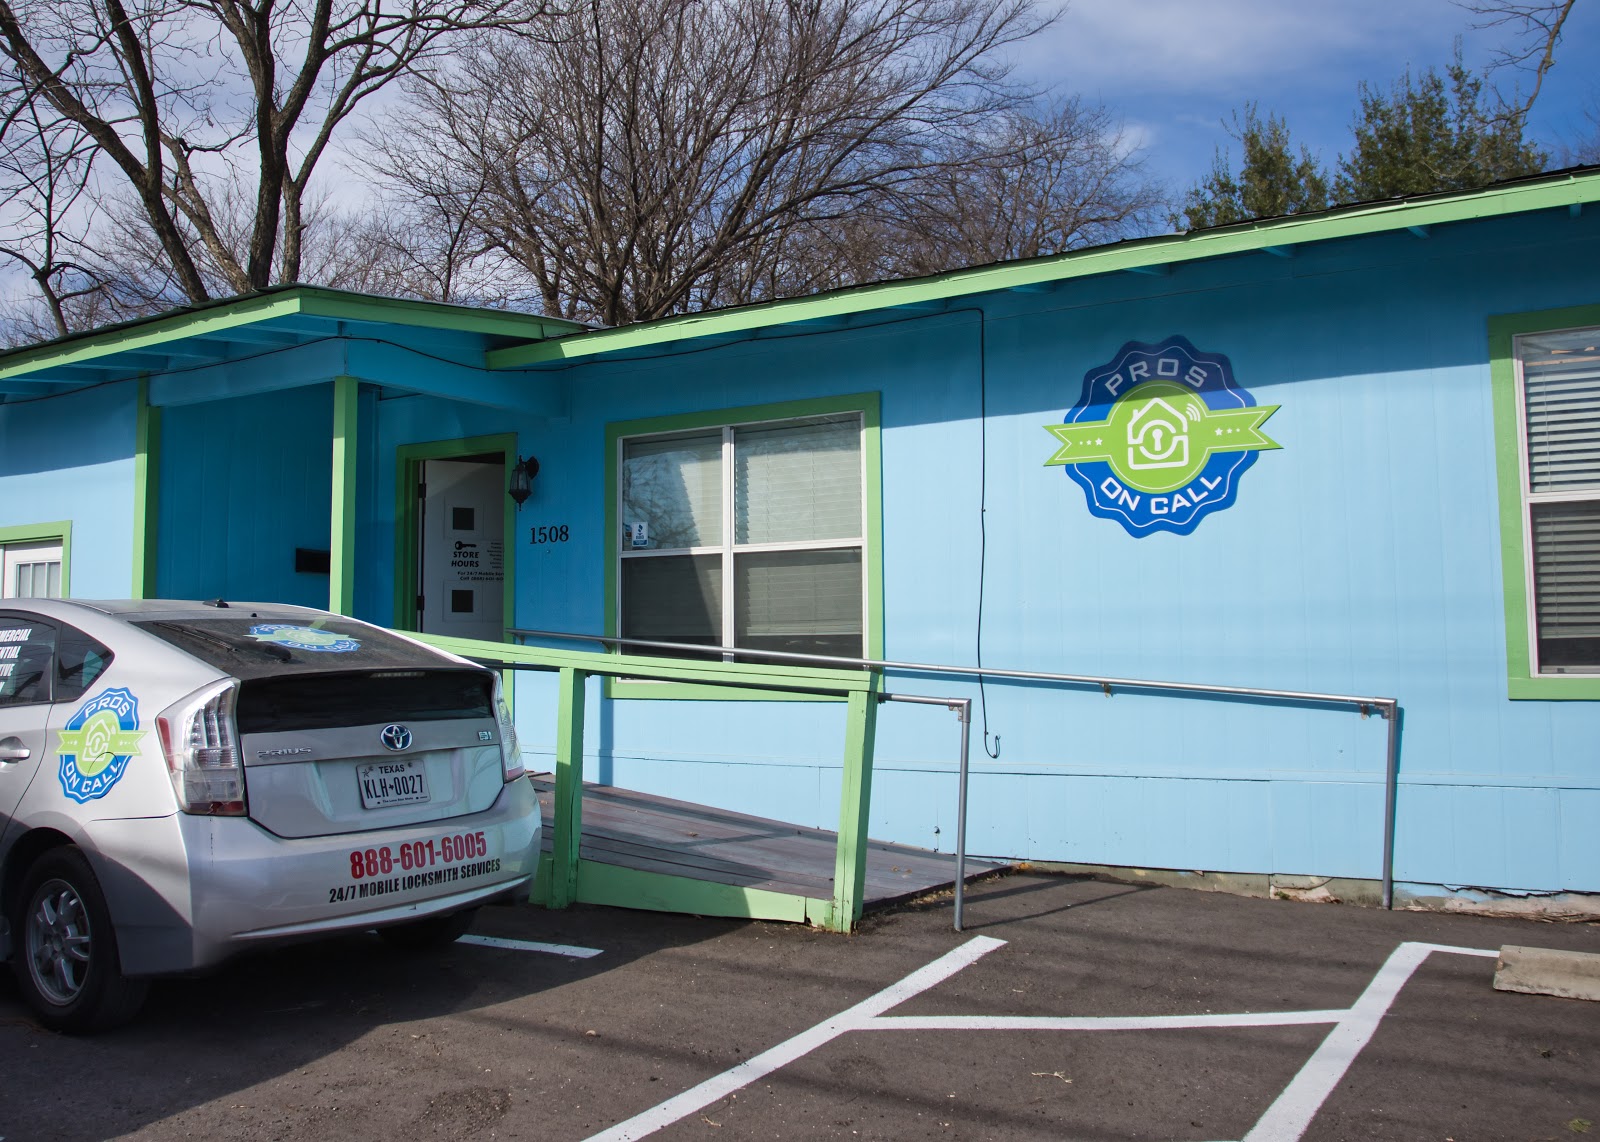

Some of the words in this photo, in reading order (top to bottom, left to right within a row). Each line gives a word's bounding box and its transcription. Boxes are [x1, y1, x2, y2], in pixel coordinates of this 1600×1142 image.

[1104, 358, 1207, 396] PROS
[1100, 476, 1141, 511] ON
[1151, 476, 1222, 514] CALL
[530, 524, 569, 544] 1508
[451, 560, 479, 568] HOURS
[453, 551, 479, 559] STORE
[84, 696, 130, 718] PROS
[65, 761, 80, 789] ON
[81, 762, 121, 792] CALL
[378, 764, 405, 774] TEXAS
[350, 831, 487, 879] 888-601-6005
[329, 885, 357, 903] 24/7
[359, 877, 400, 898] MOBILE
[402, 865, 459, 891] LOCKSMITH
[460, 857, 501, 879] SERVICES
